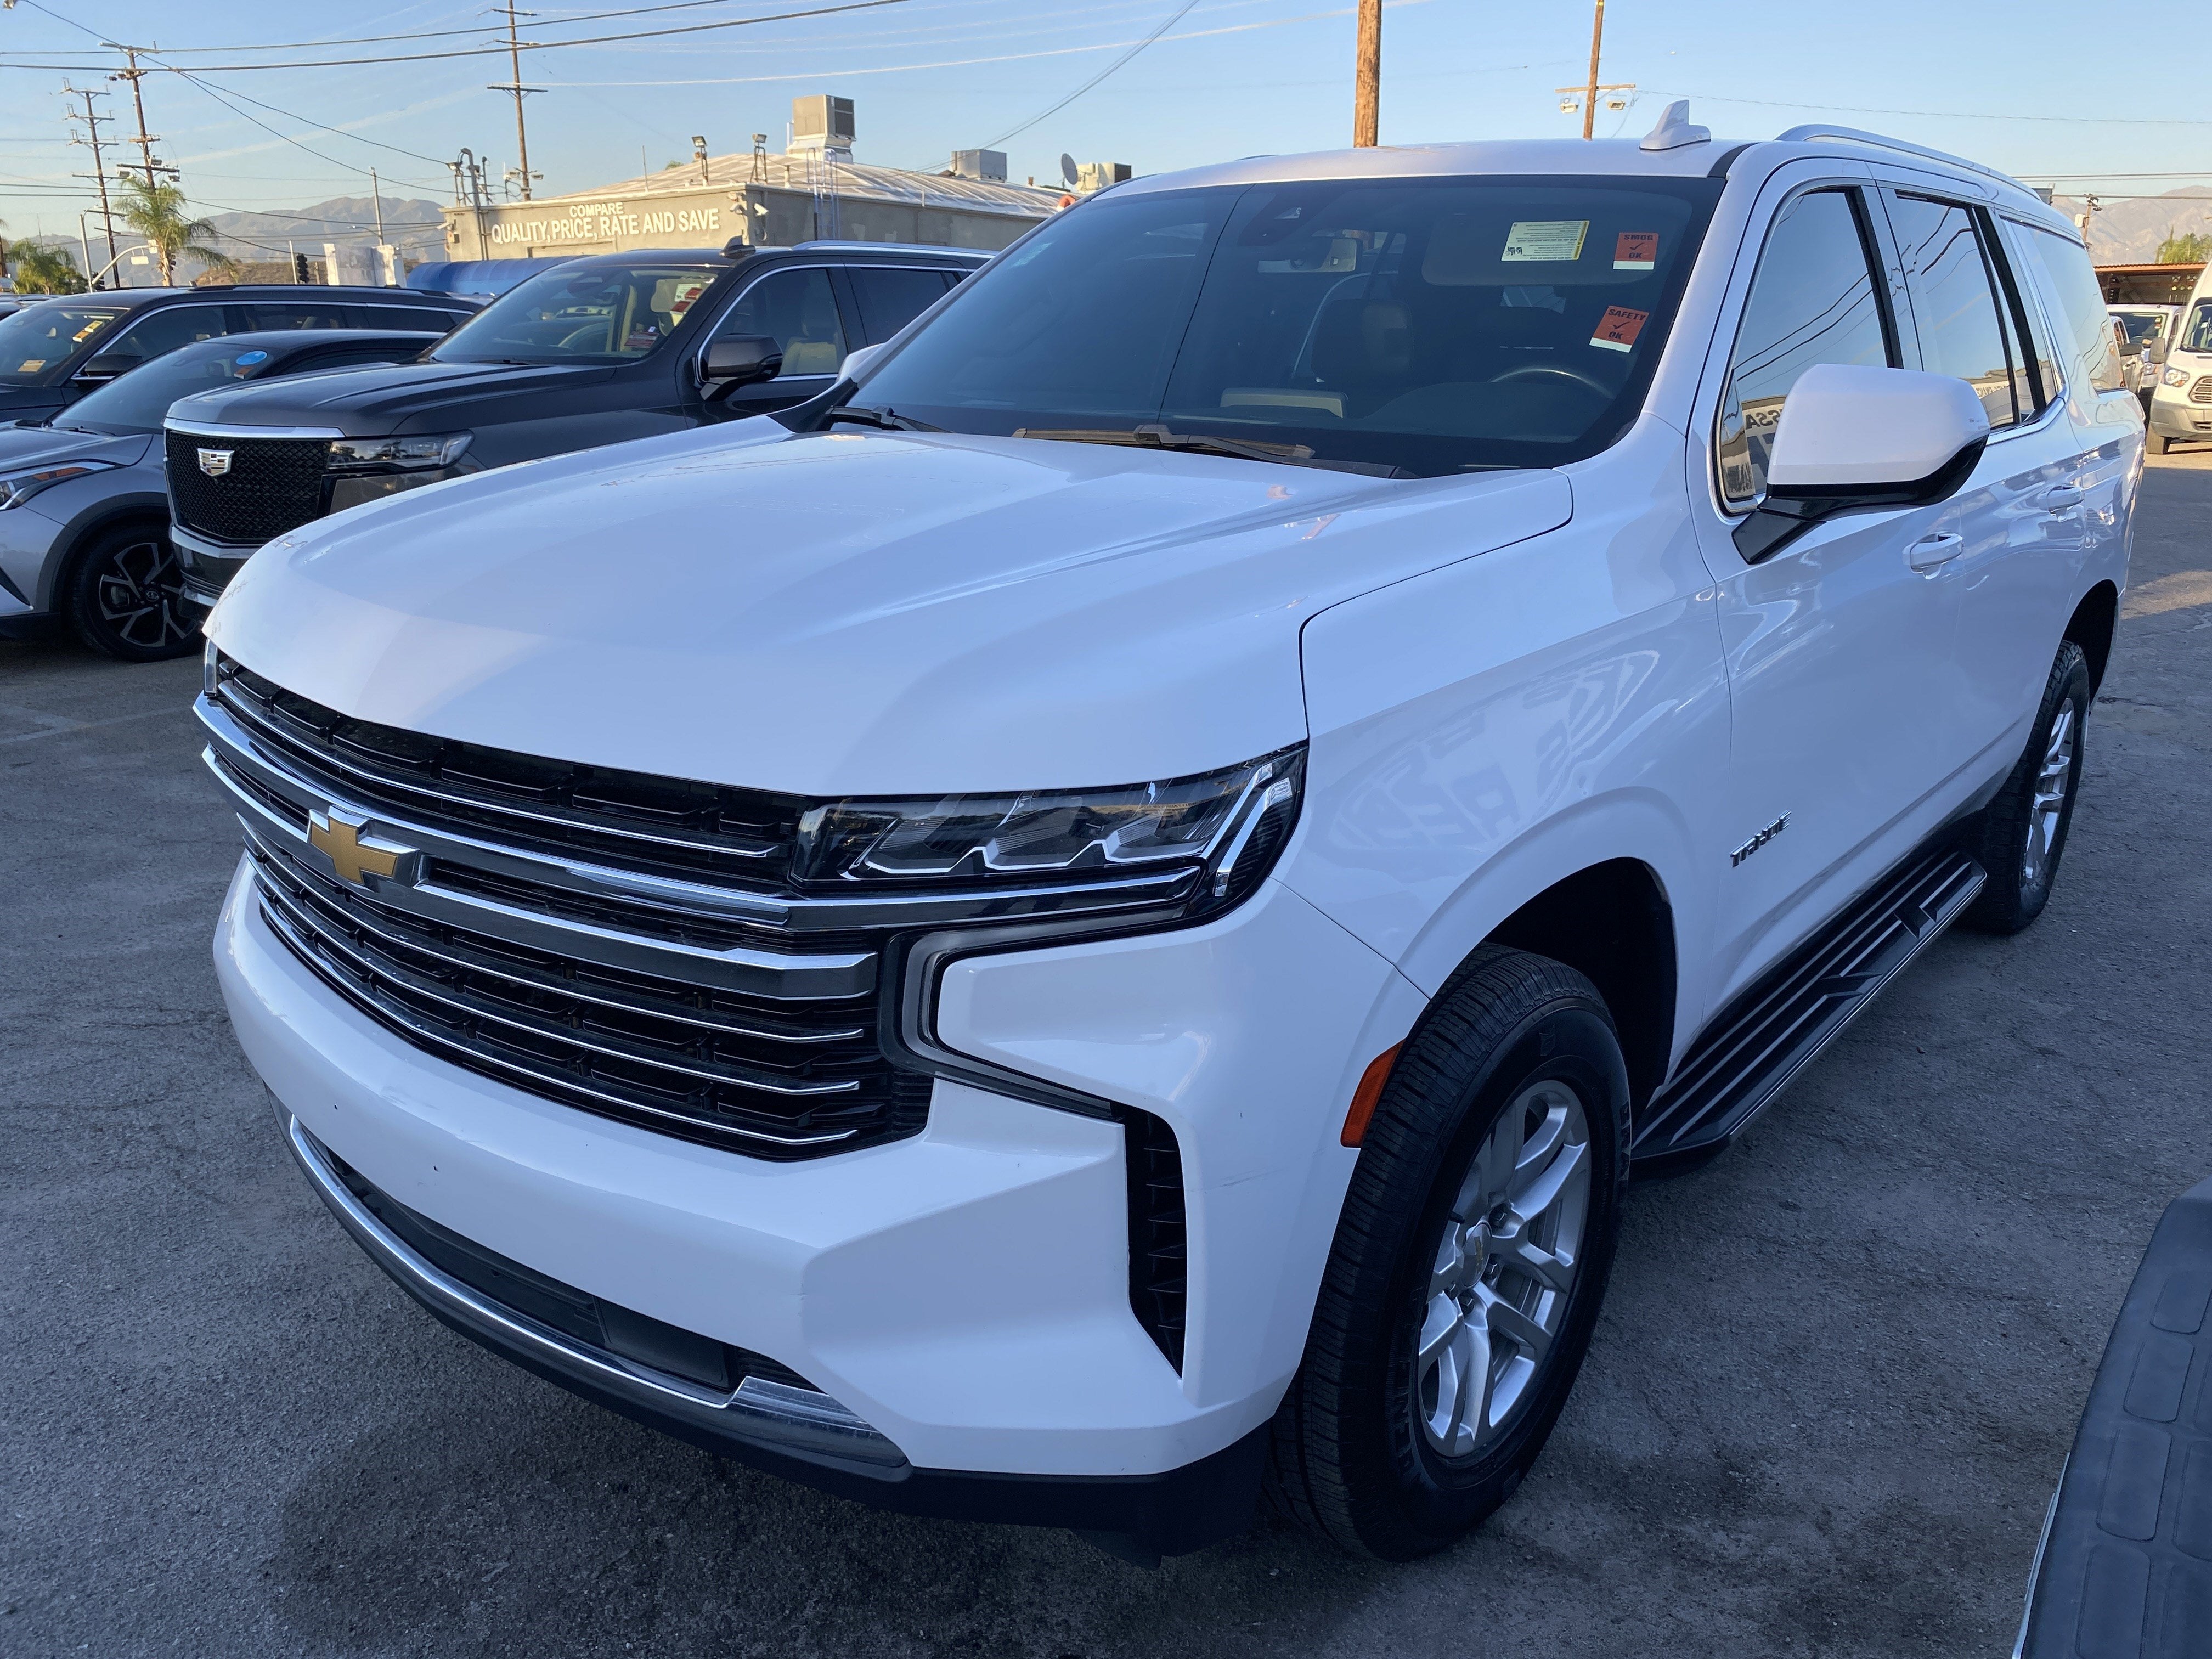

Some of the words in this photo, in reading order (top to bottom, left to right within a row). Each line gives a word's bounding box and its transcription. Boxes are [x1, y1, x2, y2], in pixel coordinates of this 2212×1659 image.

[569, 202, 624, 218] COMPARE
[492, 221, 551, 245] QUALITY,
[551, 217, 598, 241] PRICE,
[599, 214, 640, 236] RATE
[642, 211, 675, 234] AND
[678, 208, 720, 232] SAVE
[1608, 308, 1646, 321] SAFETY
[1609, 331, 1624, 340] OK
[1730, 810, 1792, 868] TAHOE
